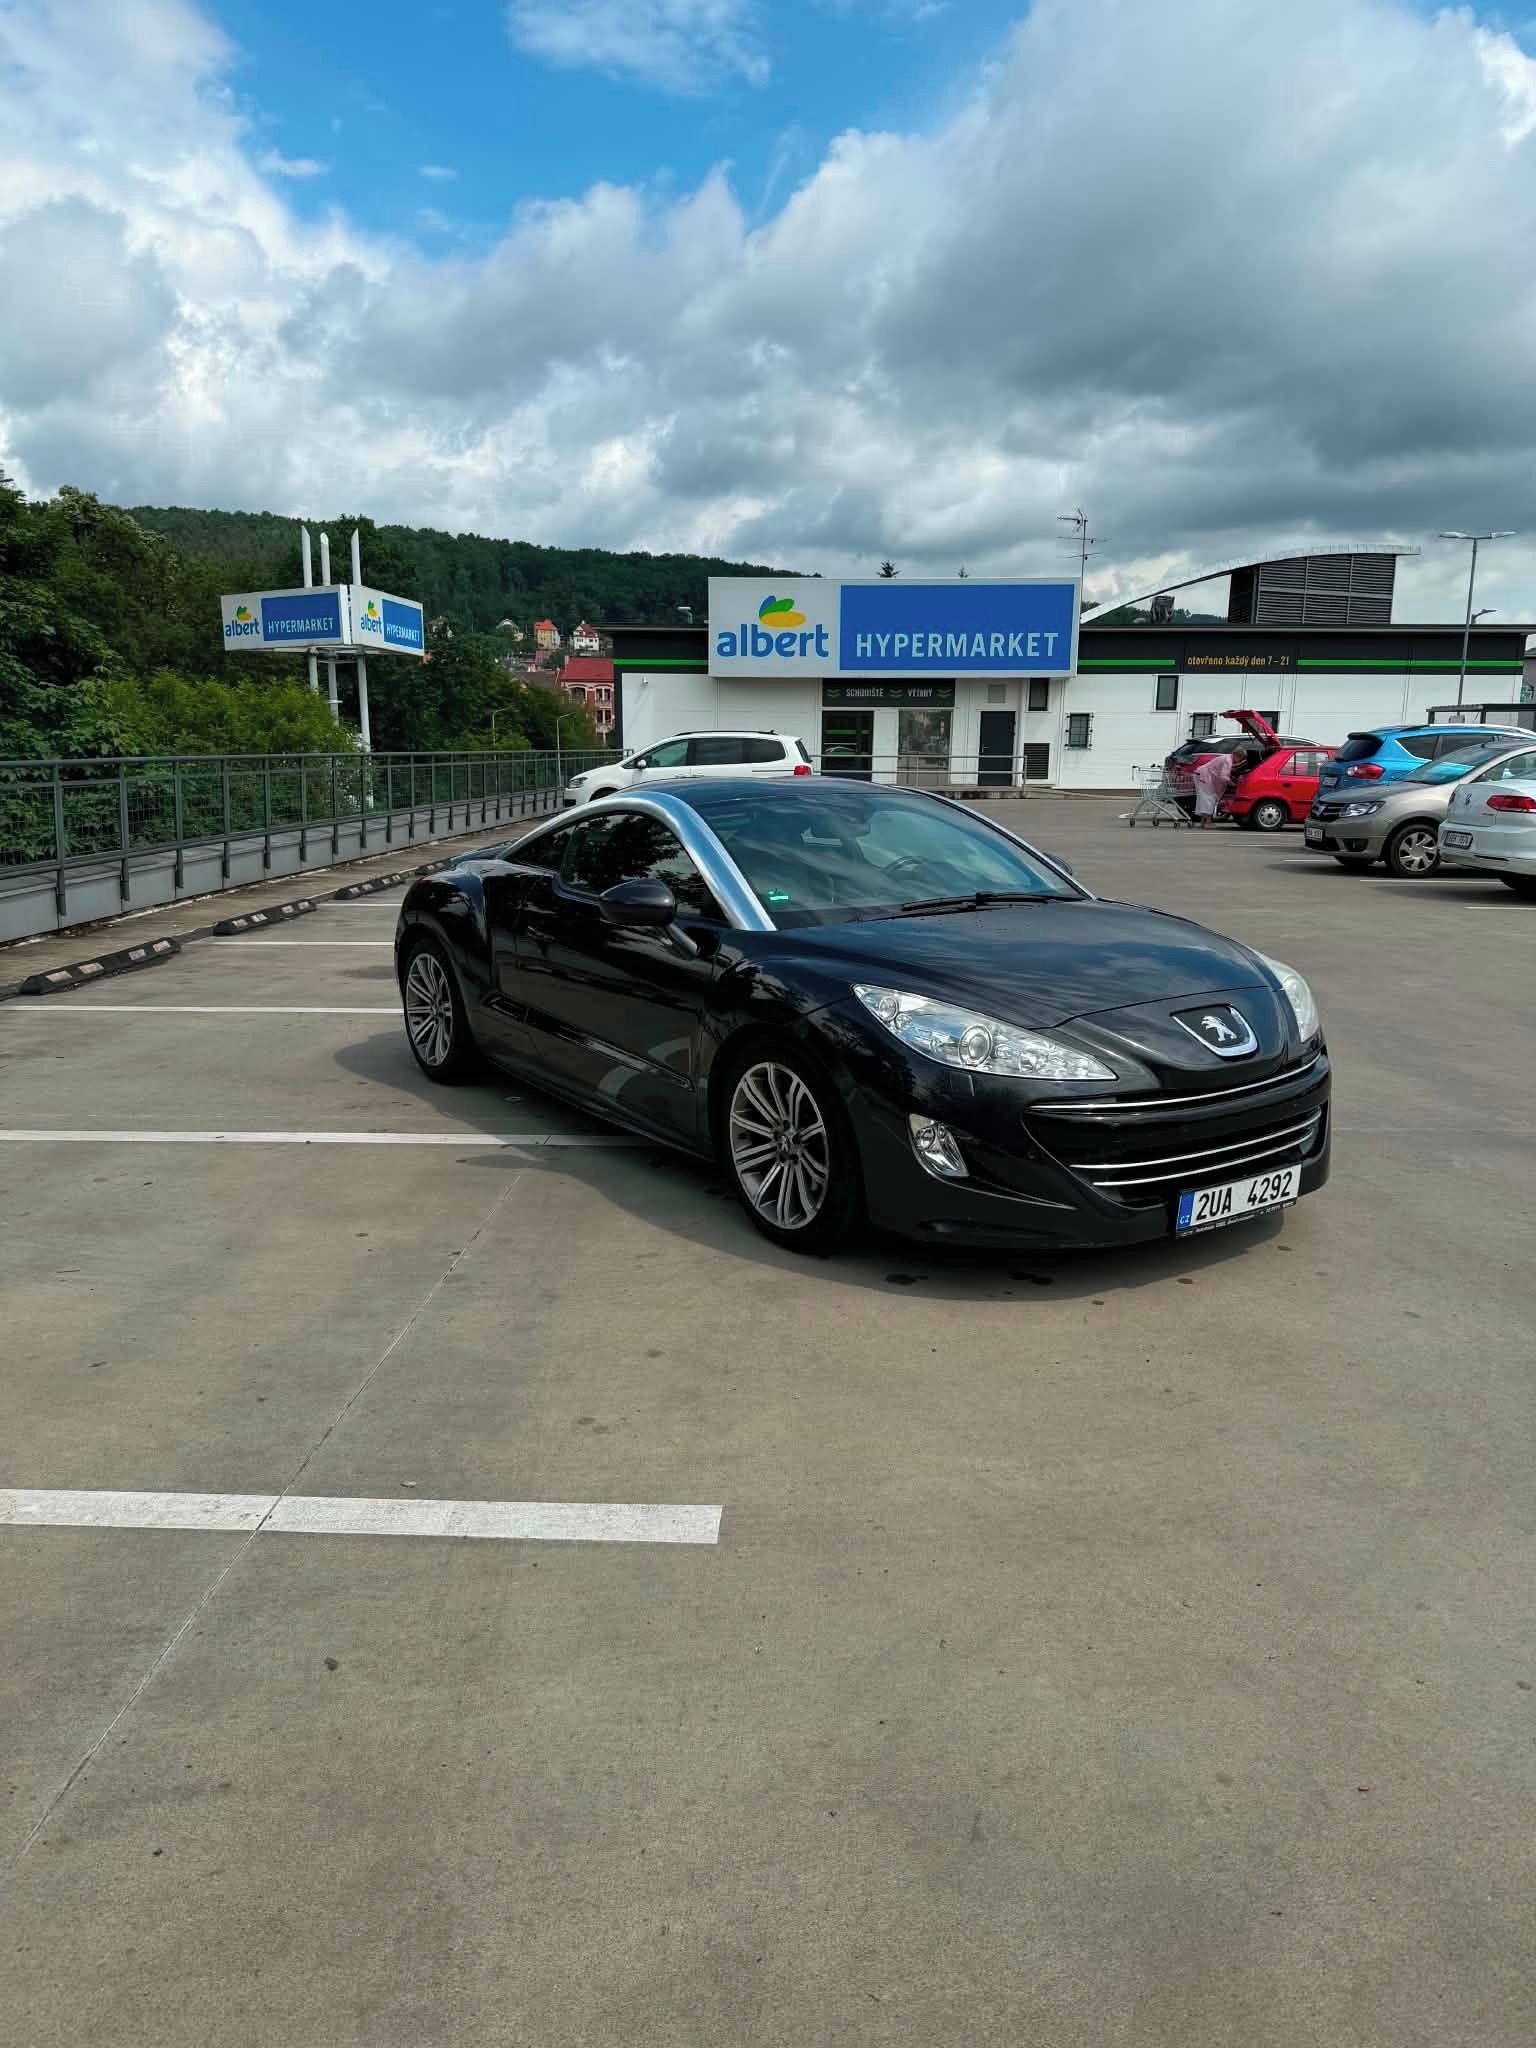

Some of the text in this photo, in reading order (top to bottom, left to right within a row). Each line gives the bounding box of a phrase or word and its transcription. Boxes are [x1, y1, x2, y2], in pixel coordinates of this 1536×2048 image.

[225, 617, 335, 637] albert HYPERMARKET
[360, 614, 420, 642] albert HYPERMARKET
[716, 623, 1059, 658] albert HYPERMARKET
[1251, 656, 1266, 665] den
[1268, 656, 1273, 665] 7
[1280, 656, 1289, 665] 21
[1195, 1171, 1293, 1221] 2UA 4292
[1180, 1215, 1190, 1225] CZ
